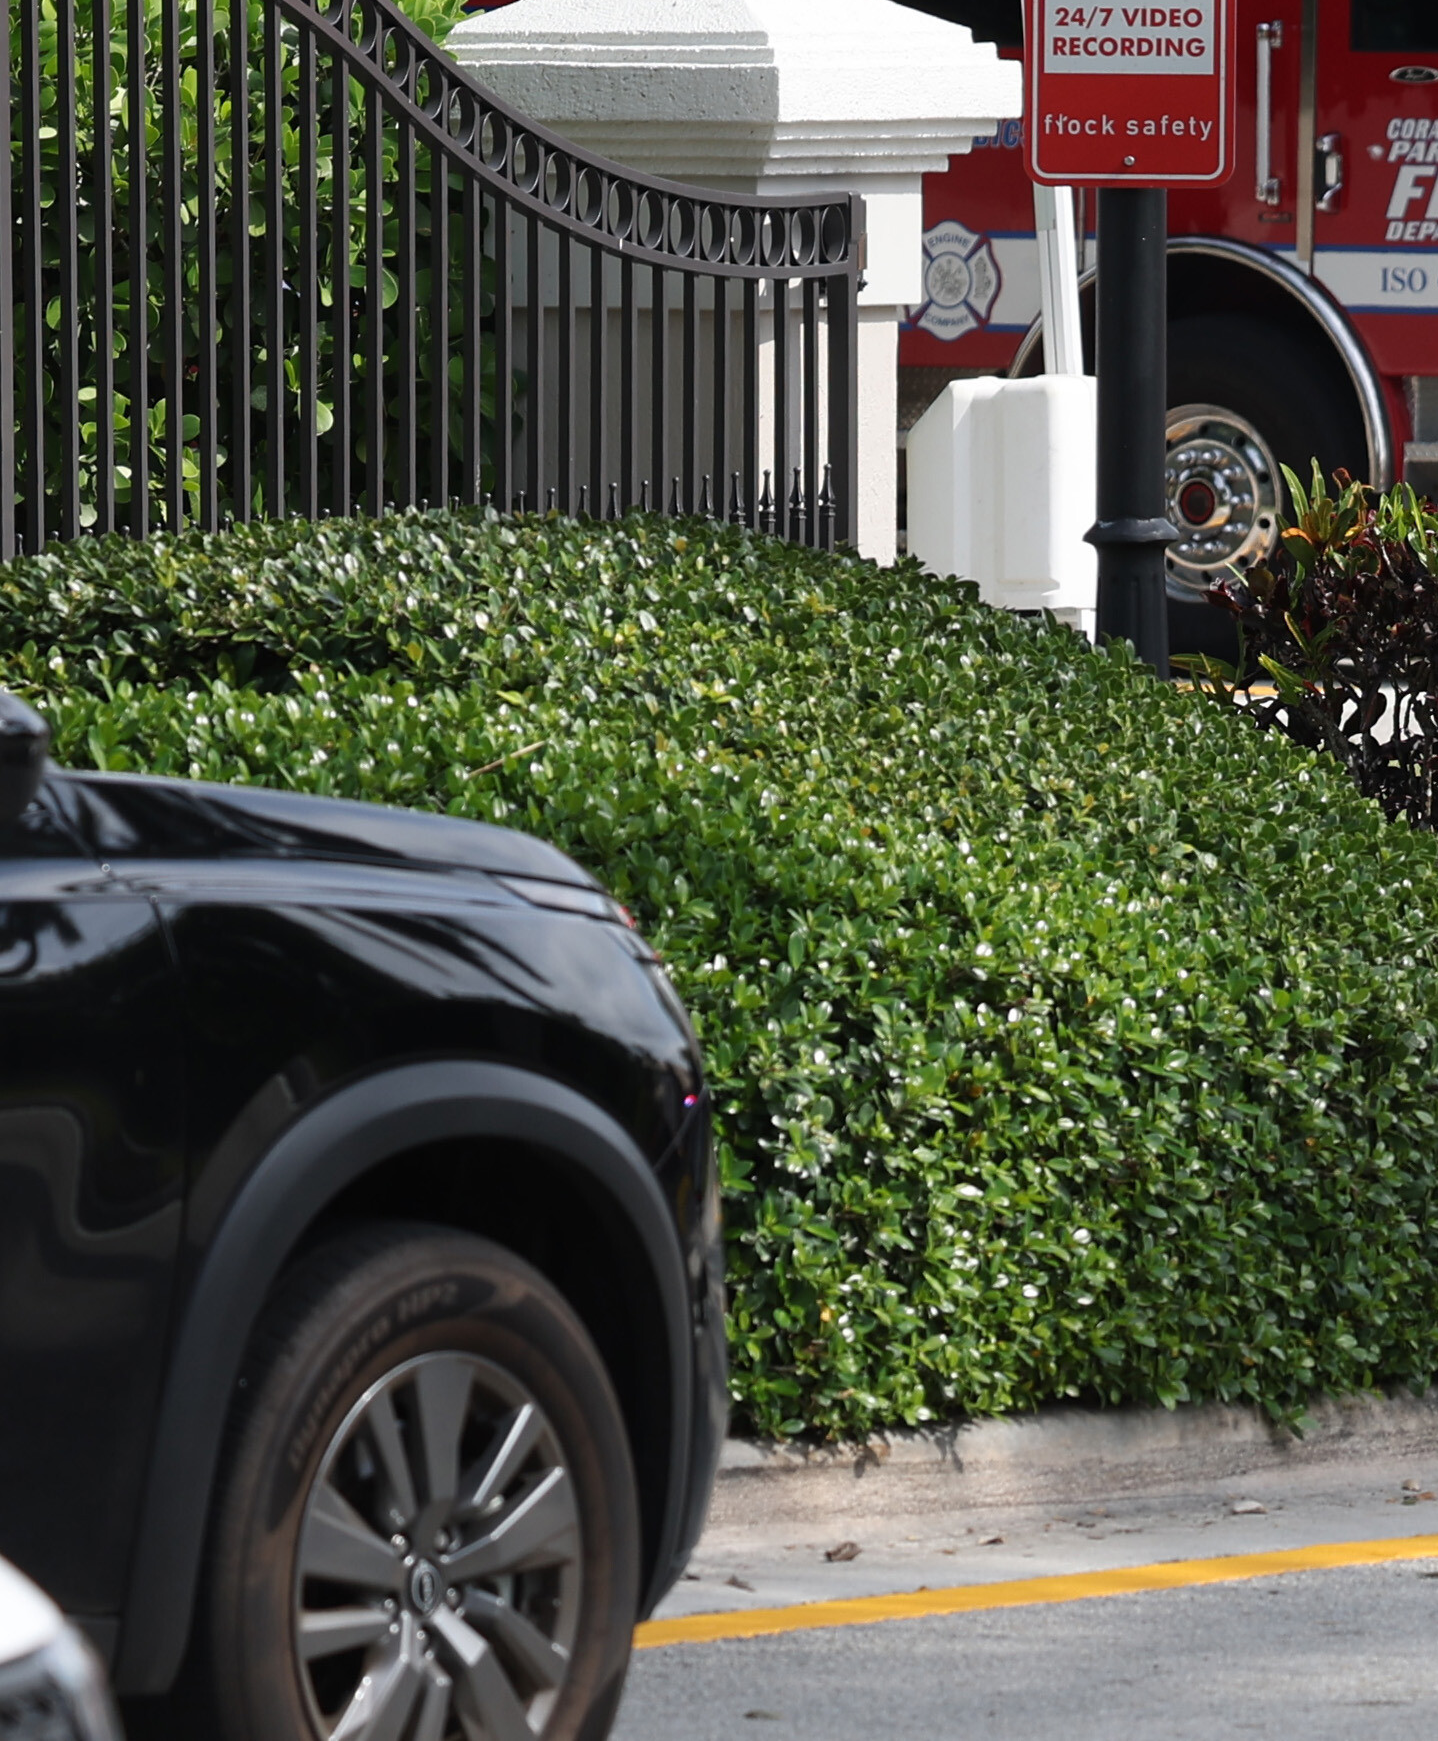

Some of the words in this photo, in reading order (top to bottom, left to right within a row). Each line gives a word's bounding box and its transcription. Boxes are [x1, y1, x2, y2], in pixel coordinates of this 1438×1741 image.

[1054, 5, 1114, 30] 24/7
[1121, 7, 1204, 28] VIDEO
[1052, 36, 1207, 58] RECORDING
[1126, 114, 1214, 142] safety
[927, 233, 970, 248] ENGINE
[1380, 266, 1428, 294] ISO
[924, 312, 970, 328] COMPANY
